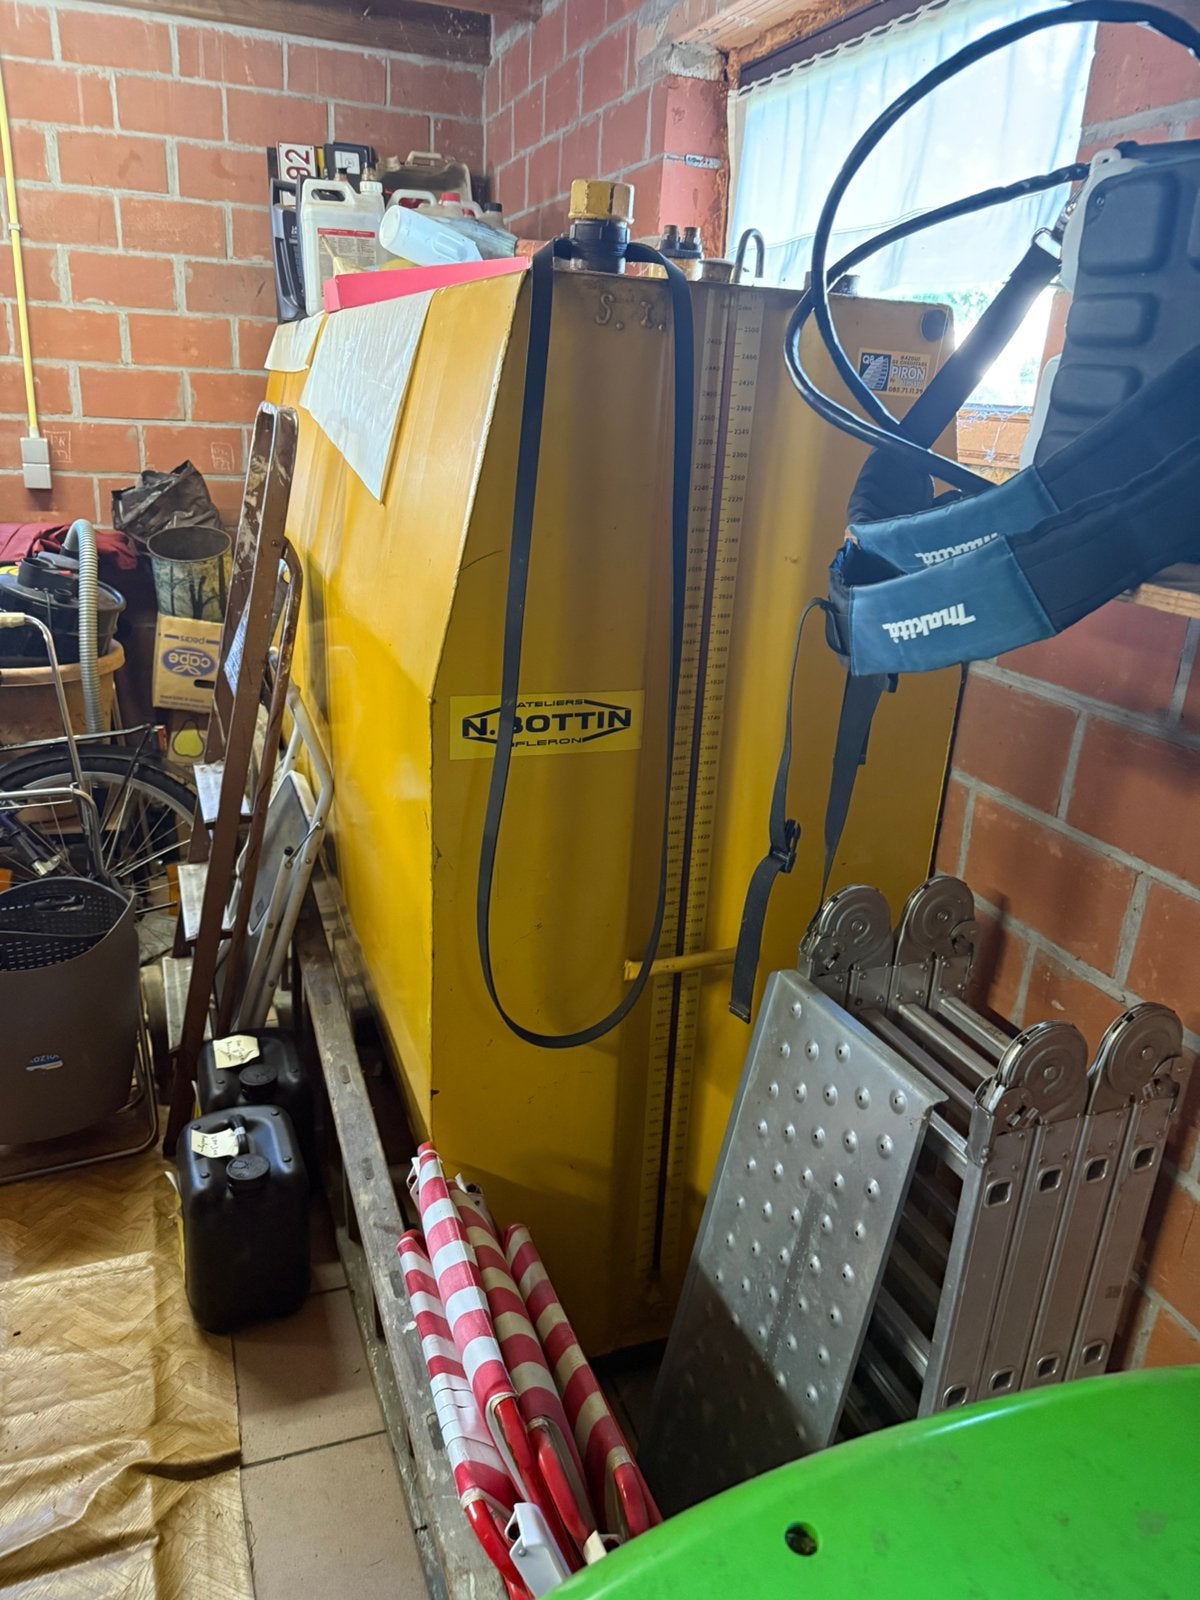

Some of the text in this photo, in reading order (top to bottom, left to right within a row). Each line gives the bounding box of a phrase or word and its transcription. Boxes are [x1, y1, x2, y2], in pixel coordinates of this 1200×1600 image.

[891, 366, 927, 380] PIRON
[168, 652, 211, 668] cape
[515, 699, 583, 708] ATELIERS
[515, 737, 583, 747] FLERON
